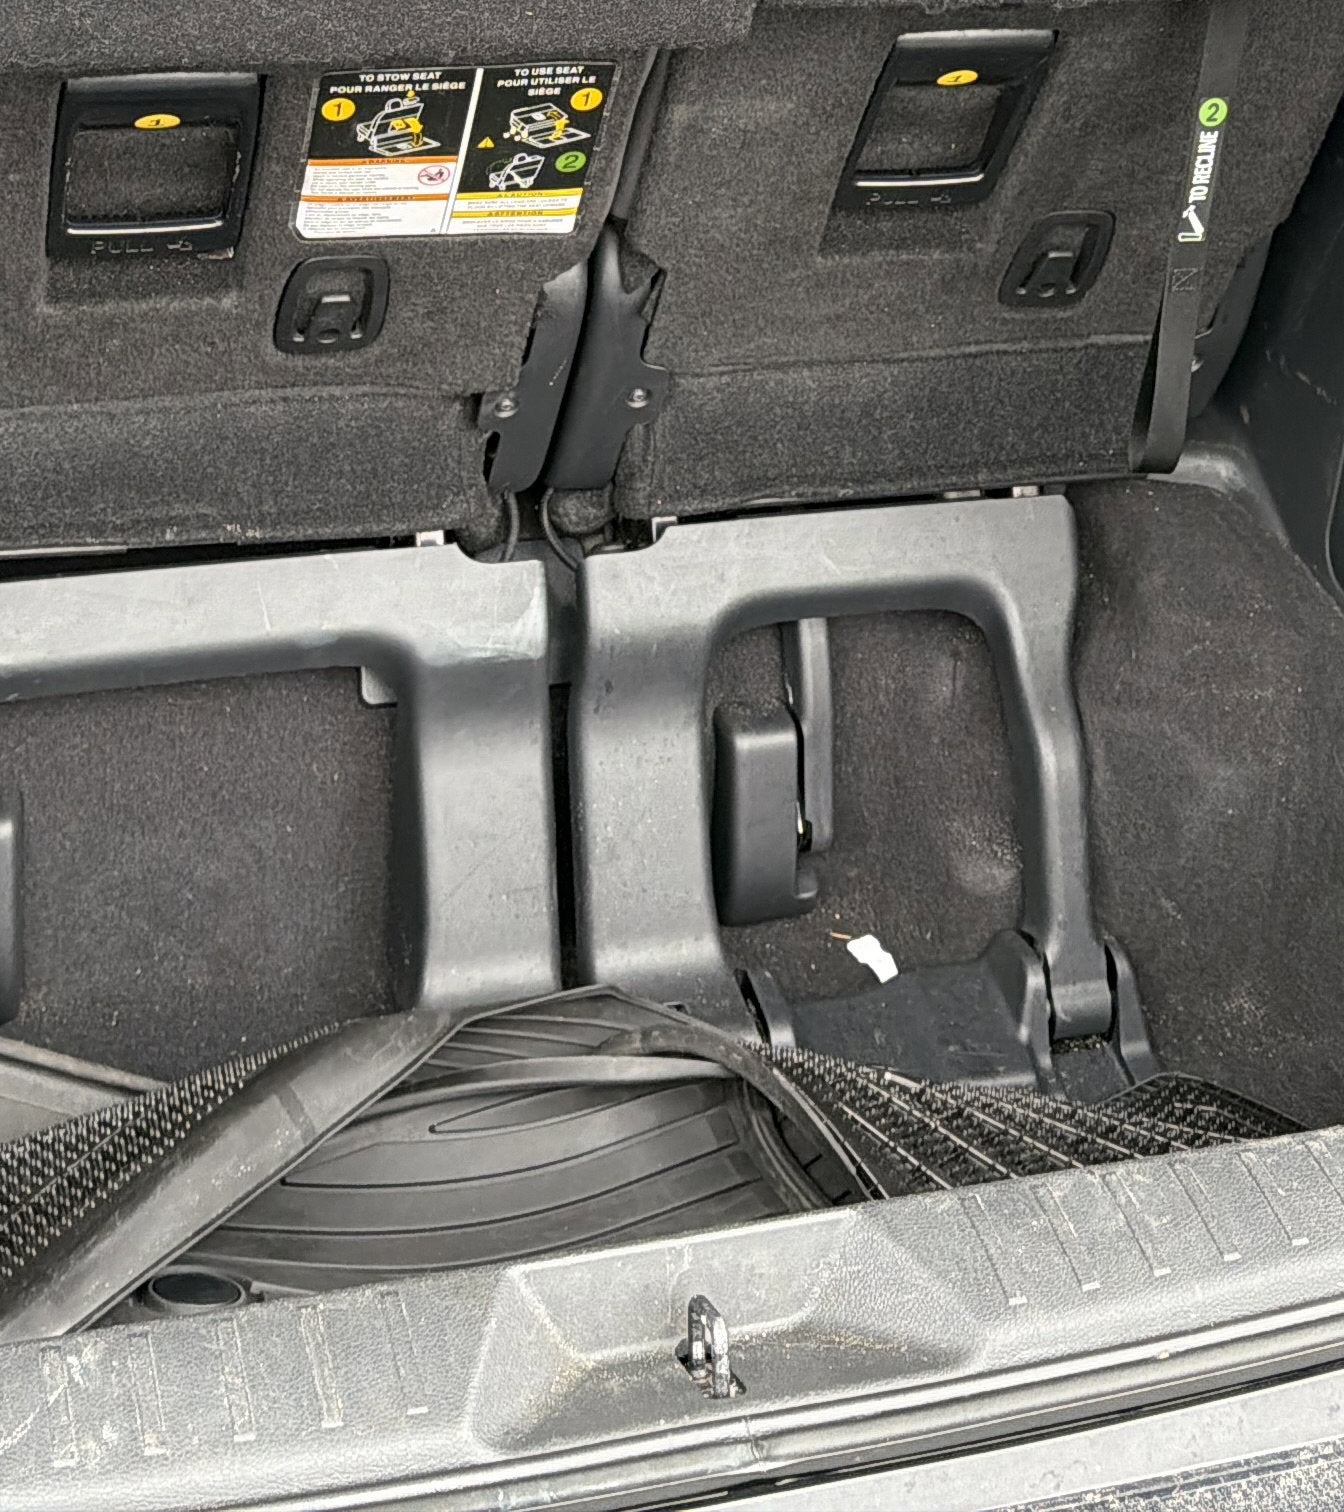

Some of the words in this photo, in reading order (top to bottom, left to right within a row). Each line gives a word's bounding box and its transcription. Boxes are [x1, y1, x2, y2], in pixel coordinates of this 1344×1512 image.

[359, 73, 375, 83] TO
[376, 72, 411, 83] STOW
[412, 71, 443, 81] SEAT
[514, 68, 530, 77] TO
[531, 67, 554, 76] USE
[555, 65, 585, 75] SEAT
[329, 86, 364, 95] POUR
[364, 83, 413, 94] RANGER
[415, 82, 431, 92] LE
[496, 78, 530, 88] POUR
[530, 76, 581, 87] UTILISER
[581, 75, 597, 85] LE
[582, 92, 592, 107] 1
[333, 102, 343, 118] 1
[1206, 102, 1220, 123] 2
[561, 154, 579, 170] 2
[1191, 130, 1220, 185] RECLINE
[1188, 185, 1209, 204] TO
